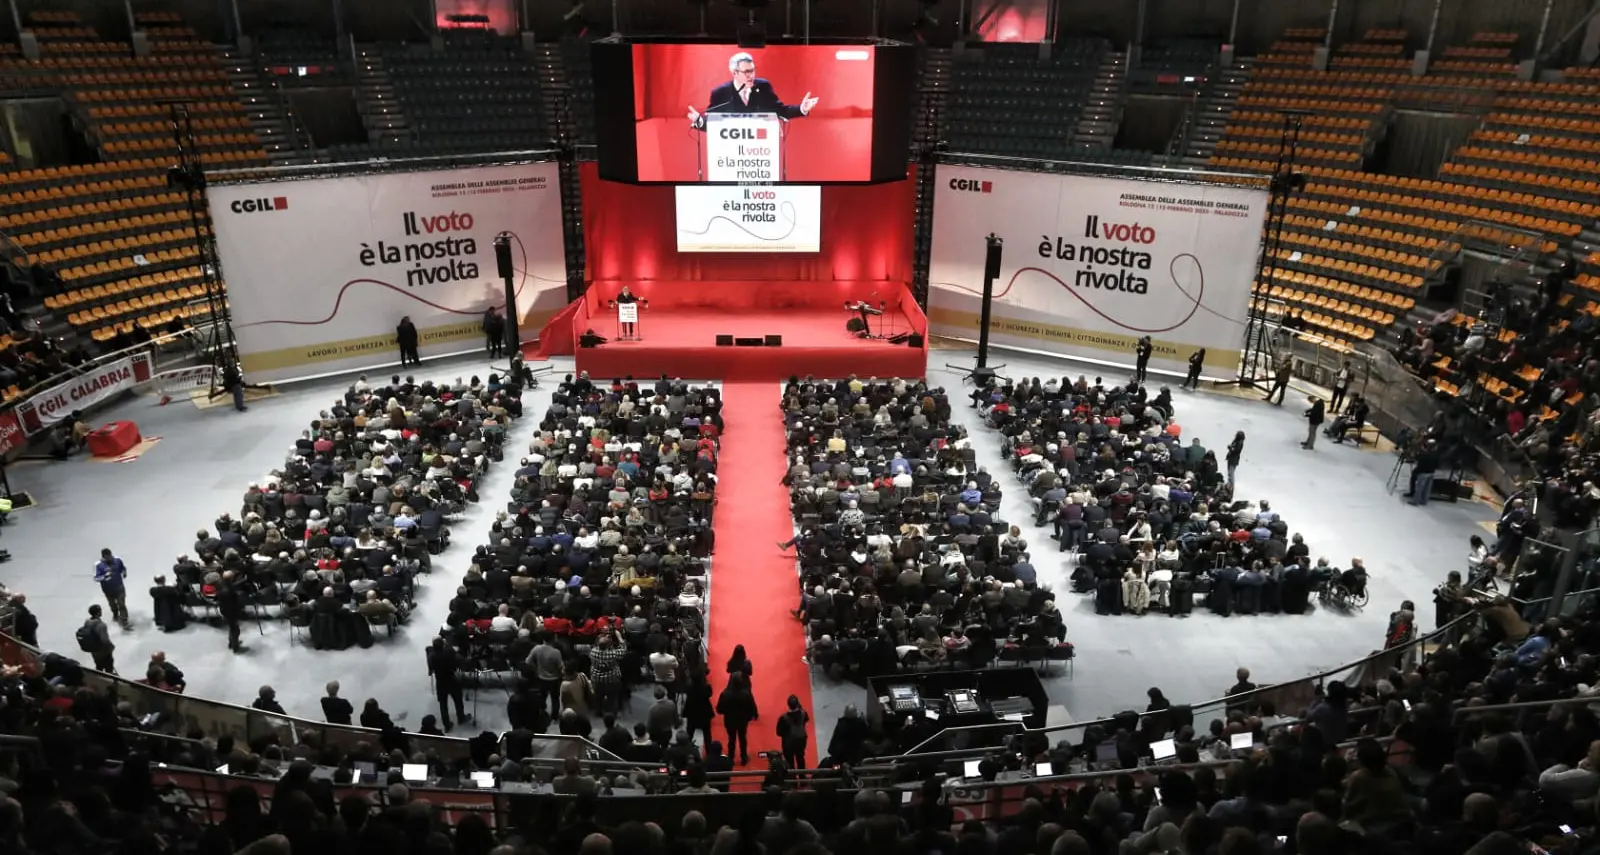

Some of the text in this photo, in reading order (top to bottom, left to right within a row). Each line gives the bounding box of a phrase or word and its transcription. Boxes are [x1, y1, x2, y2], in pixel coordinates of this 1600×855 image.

[720, 128, 754, 140] CGIL
[738, 145, 771, 156] Il voto
[717, 156, 771, 167] è la nostra
[736, 168, 771, 179] rivolta
[431, 183, 466, 191] ASSEMBLEA
[743, 188, 776, 199] Il voto
[949, 178, 981, 192] CGIL
[231, 198, 274, 214] CGIL
[722, 200, 776, 211] è la nostra
[1120, 193, 1249, 211] ASSEMBLEA DELLE ASSEMBLEE GENERALI
[403, 210, 474, 236] Il voto
[742, 212, 776, 223] rivolta
[1085, 215, 1156, 244] Il voto
[359, 236, 477, 266] è la nostra
[1038, 235, 1152, 270] è la nostra
[406, 259, 479, 287] rivolta
[1075, 265, 1149, 295] rivolta
[307, 348, 338, 358] LAVORO
[344, 341, 383, 352] SICUREZZA
[424, 328, 472, 340] CITTADINANZA
[1006, 322, 1040, 334] SICUREZZA
[1045, 327, 1072, 339] DIGNITÀ
[1077, 334, 1126, 347] CITTADINANZA
[38, 367, 131, 416] CGIL CALABRIA
